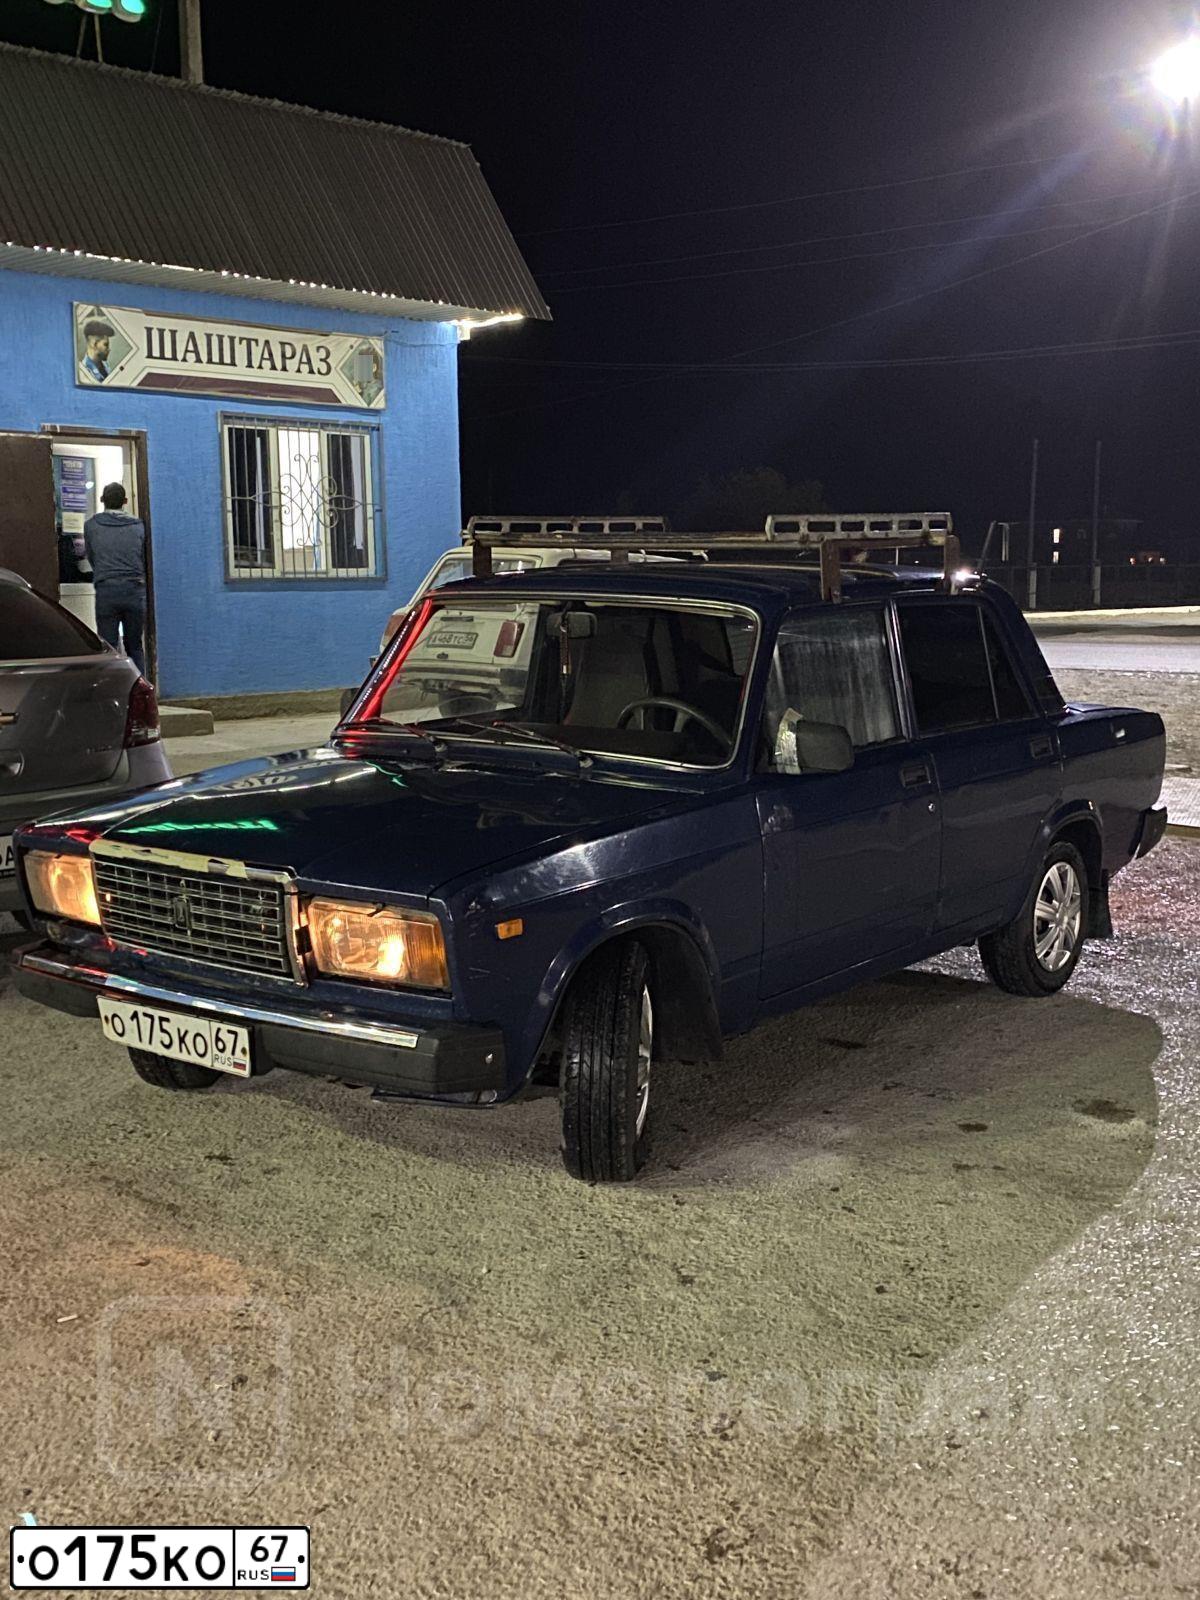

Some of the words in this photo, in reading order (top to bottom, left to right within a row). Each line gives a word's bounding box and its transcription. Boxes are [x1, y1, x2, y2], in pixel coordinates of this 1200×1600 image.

[144, 326, 332, 376] ШАШТАРАЗ
[214, 1027, 238, 1056] 67
[214, 1053, 232, 1067] RUS
